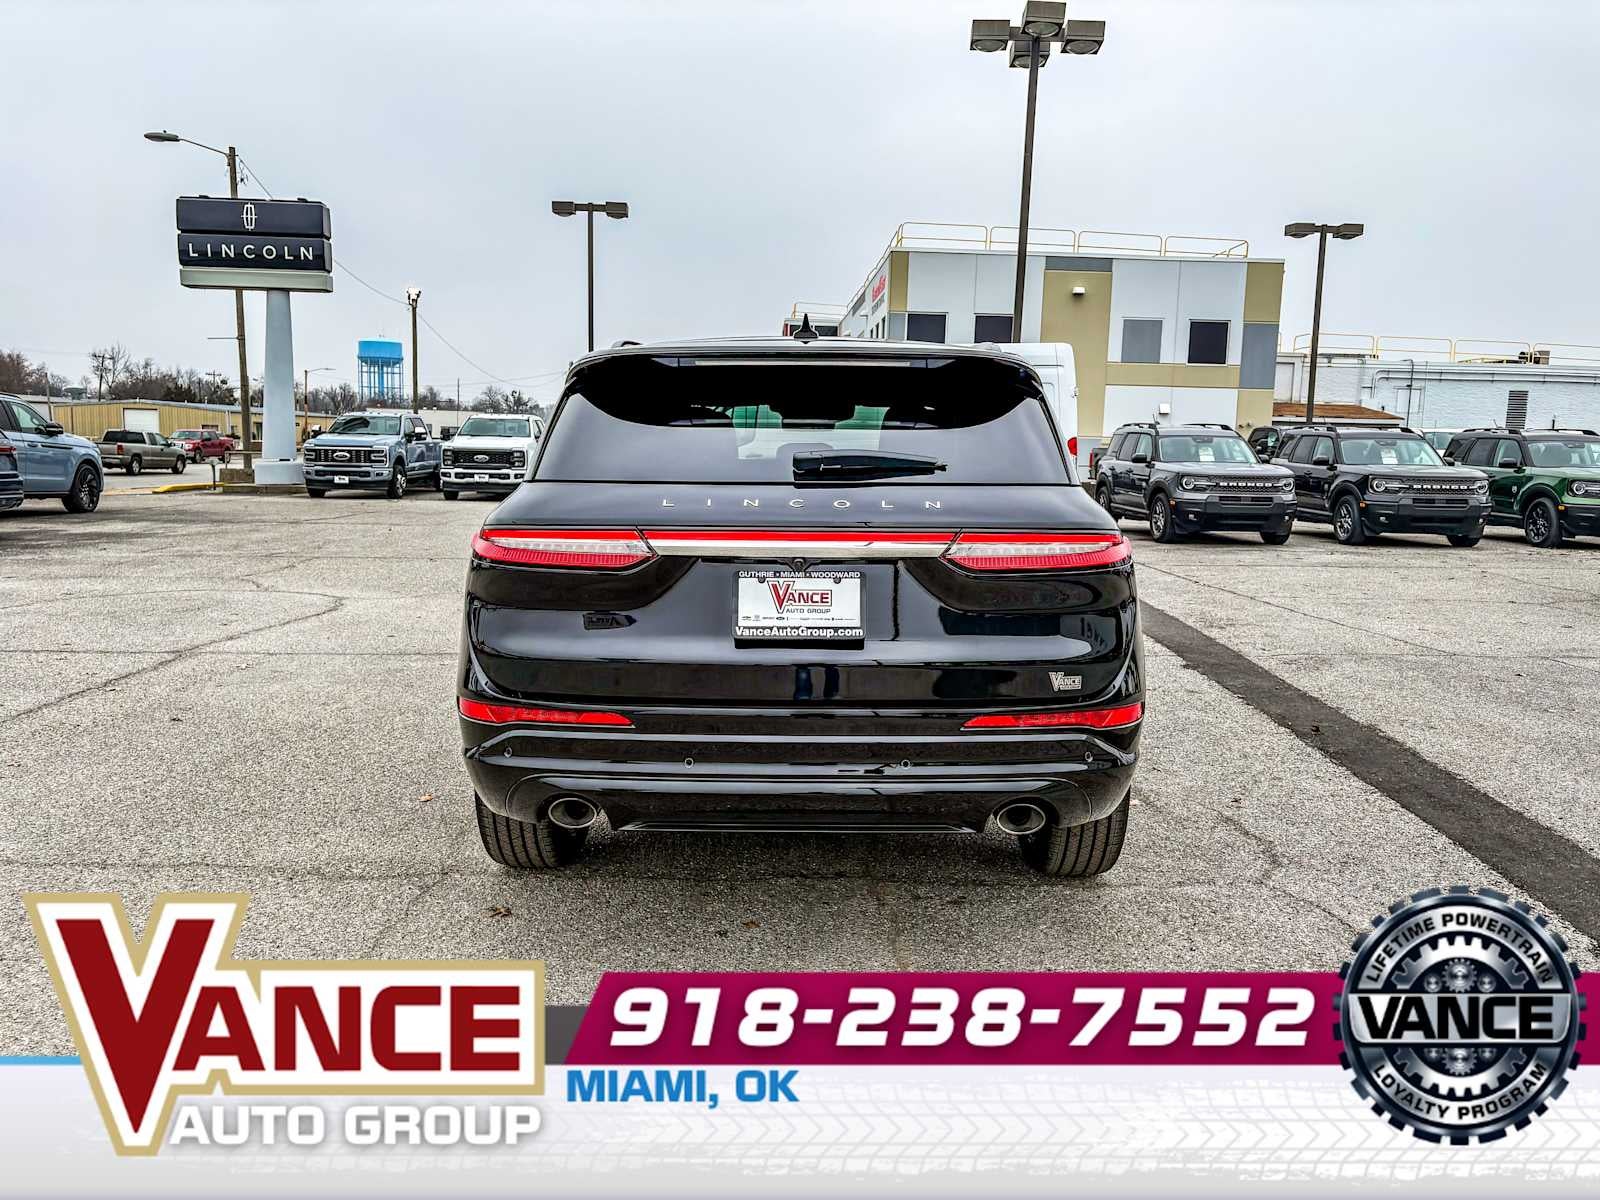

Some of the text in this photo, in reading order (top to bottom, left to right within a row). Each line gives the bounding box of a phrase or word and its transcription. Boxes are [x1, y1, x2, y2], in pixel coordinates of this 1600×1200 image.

[188, 243, 313, 260] LINCOLN
[662, 499, 941, 509] LINCOLN
[770, 583, 830, 610] VANCE
[735, 627, 864, 638] VanceAutoGroup.com
[1048, 672, 1081, 691] VANCE
